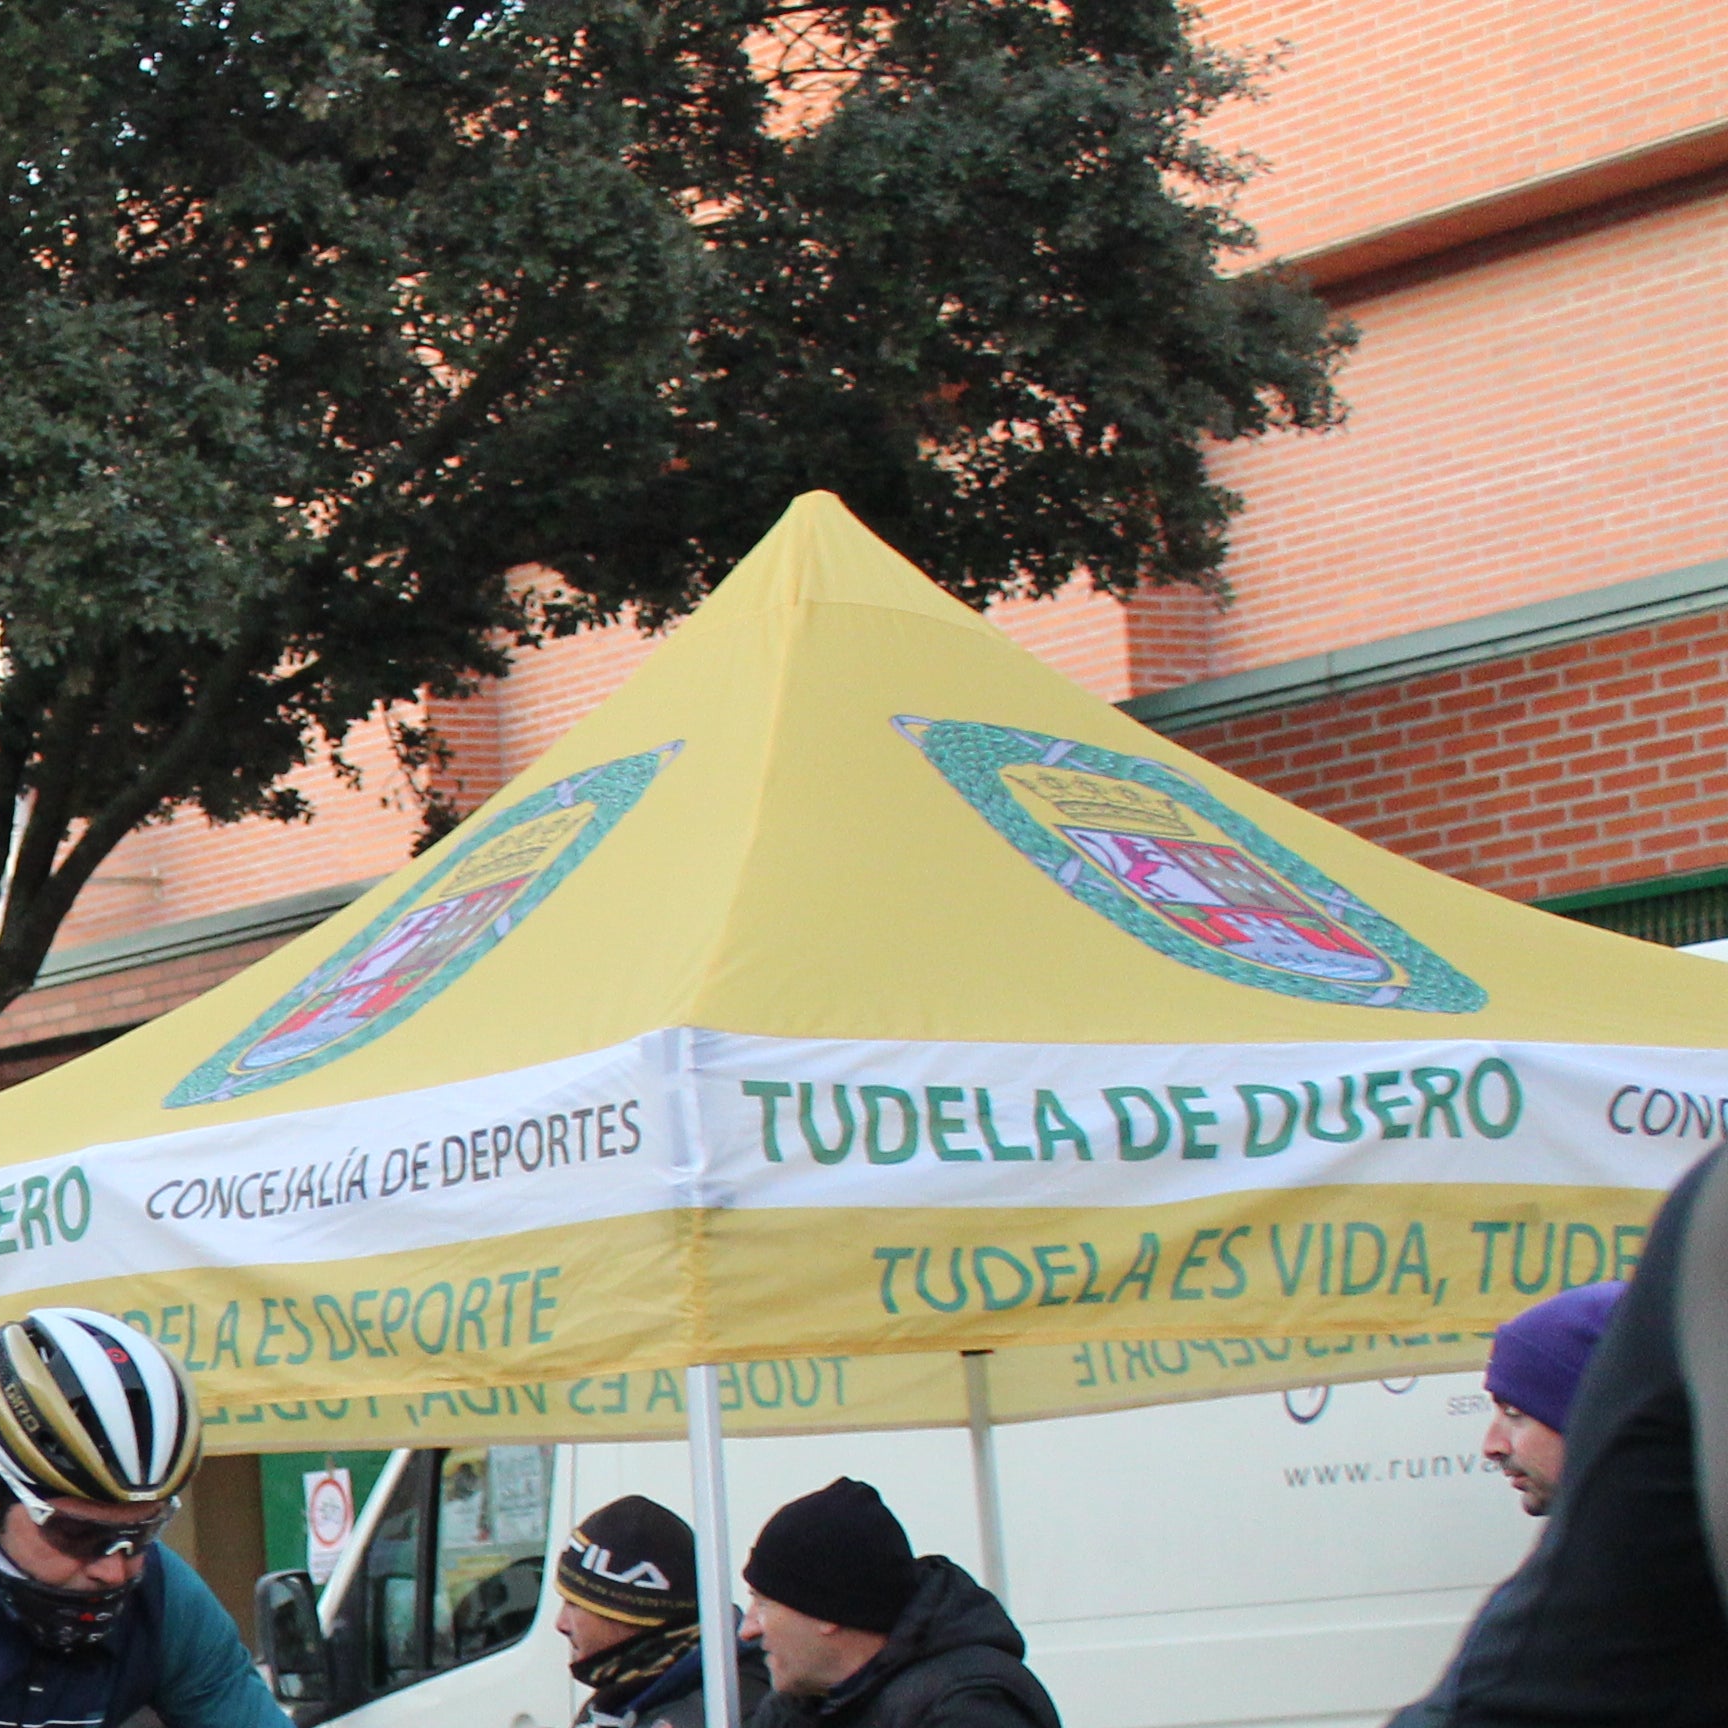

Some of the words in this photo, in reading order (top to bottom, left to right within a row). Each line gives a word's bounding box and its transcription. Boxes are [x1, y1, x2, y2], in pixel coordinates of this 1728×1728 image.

[145, 1146, 368, 1220] CONCEJALÍA
[380, 1141, 432, 1196] DE
[441, 1099, 640, 1187] DEPORTES
[741, 1079, 1091, 1165] TUDELA
[1103, 1085, 1220, 1160] DE
[1238, 1057, 1522, 1158] DUERO
[253, 1297, 313, 1367] ES
[314, 1266, 562, 1362] DEPORTE
[873, 1231, 1158, 1314] TUDELA
[1171, 1224, 1248, 1303] ES
[1269, 1222, 1447, 1306] VIDA,
